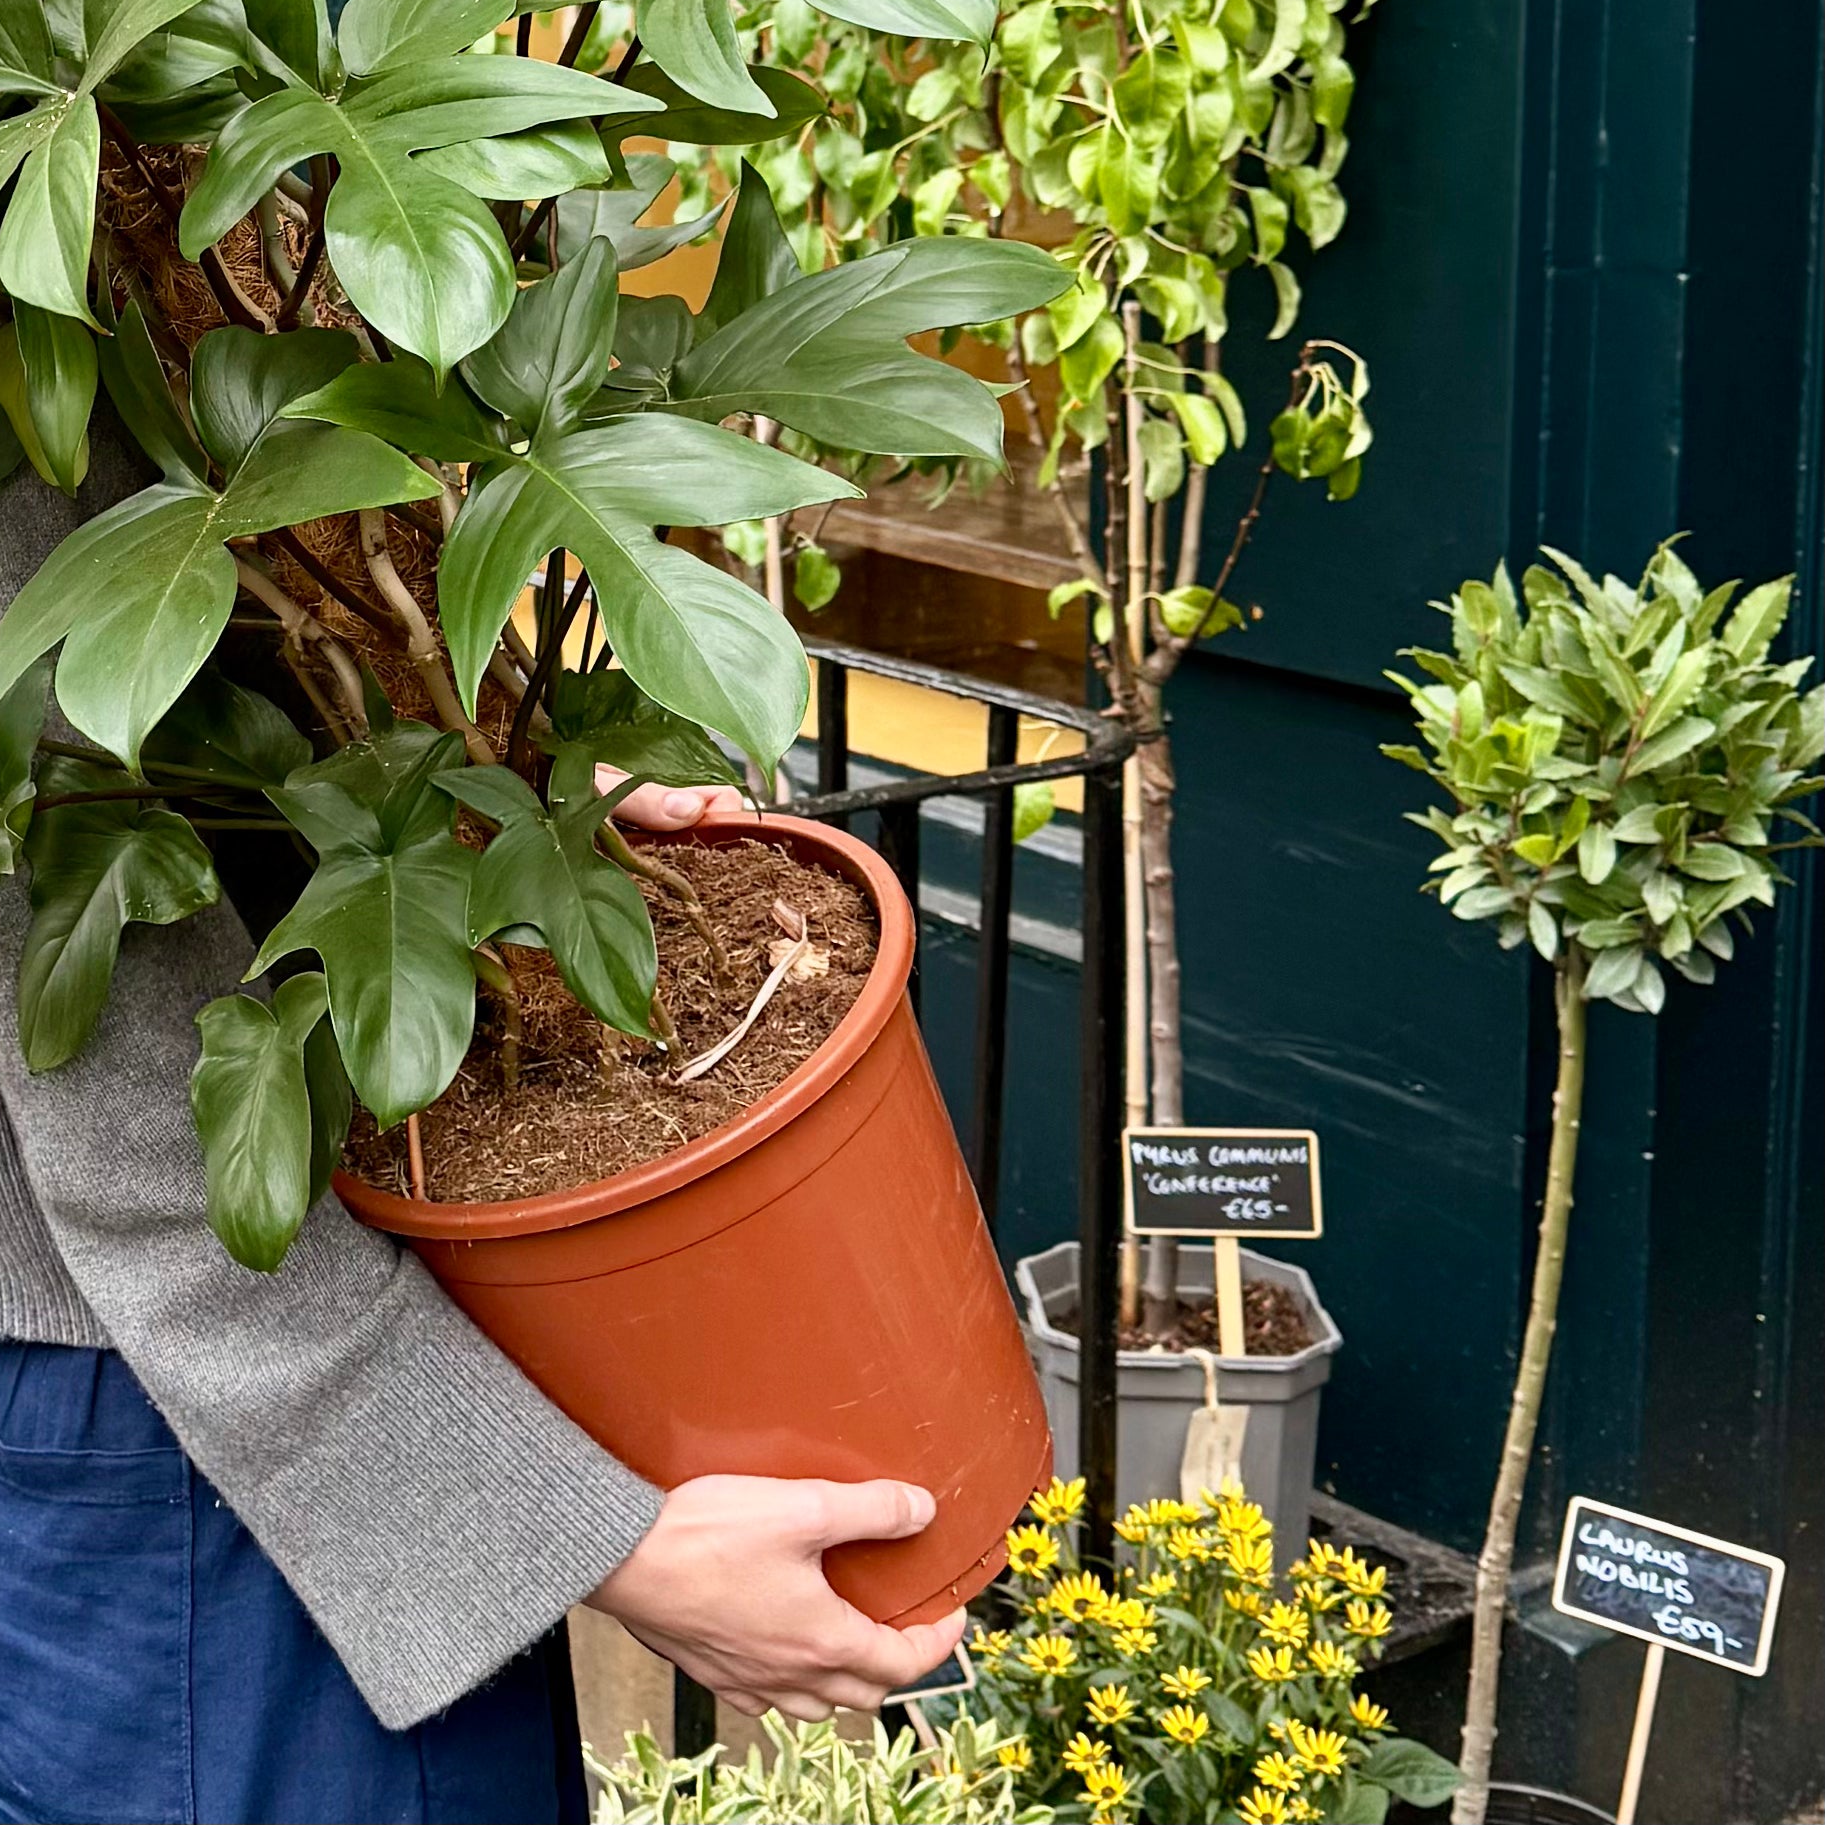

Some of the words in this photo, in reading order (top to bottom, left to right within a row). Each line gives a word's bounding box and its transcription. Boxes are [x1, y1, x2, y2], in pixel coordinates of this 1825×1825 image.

[1208, 1145, 1308, 1168] COMMUNIS
[1578, 1522, 1690, 1576] LAURUS
[1576, 1554, 1694, 1604] NOBILIS
